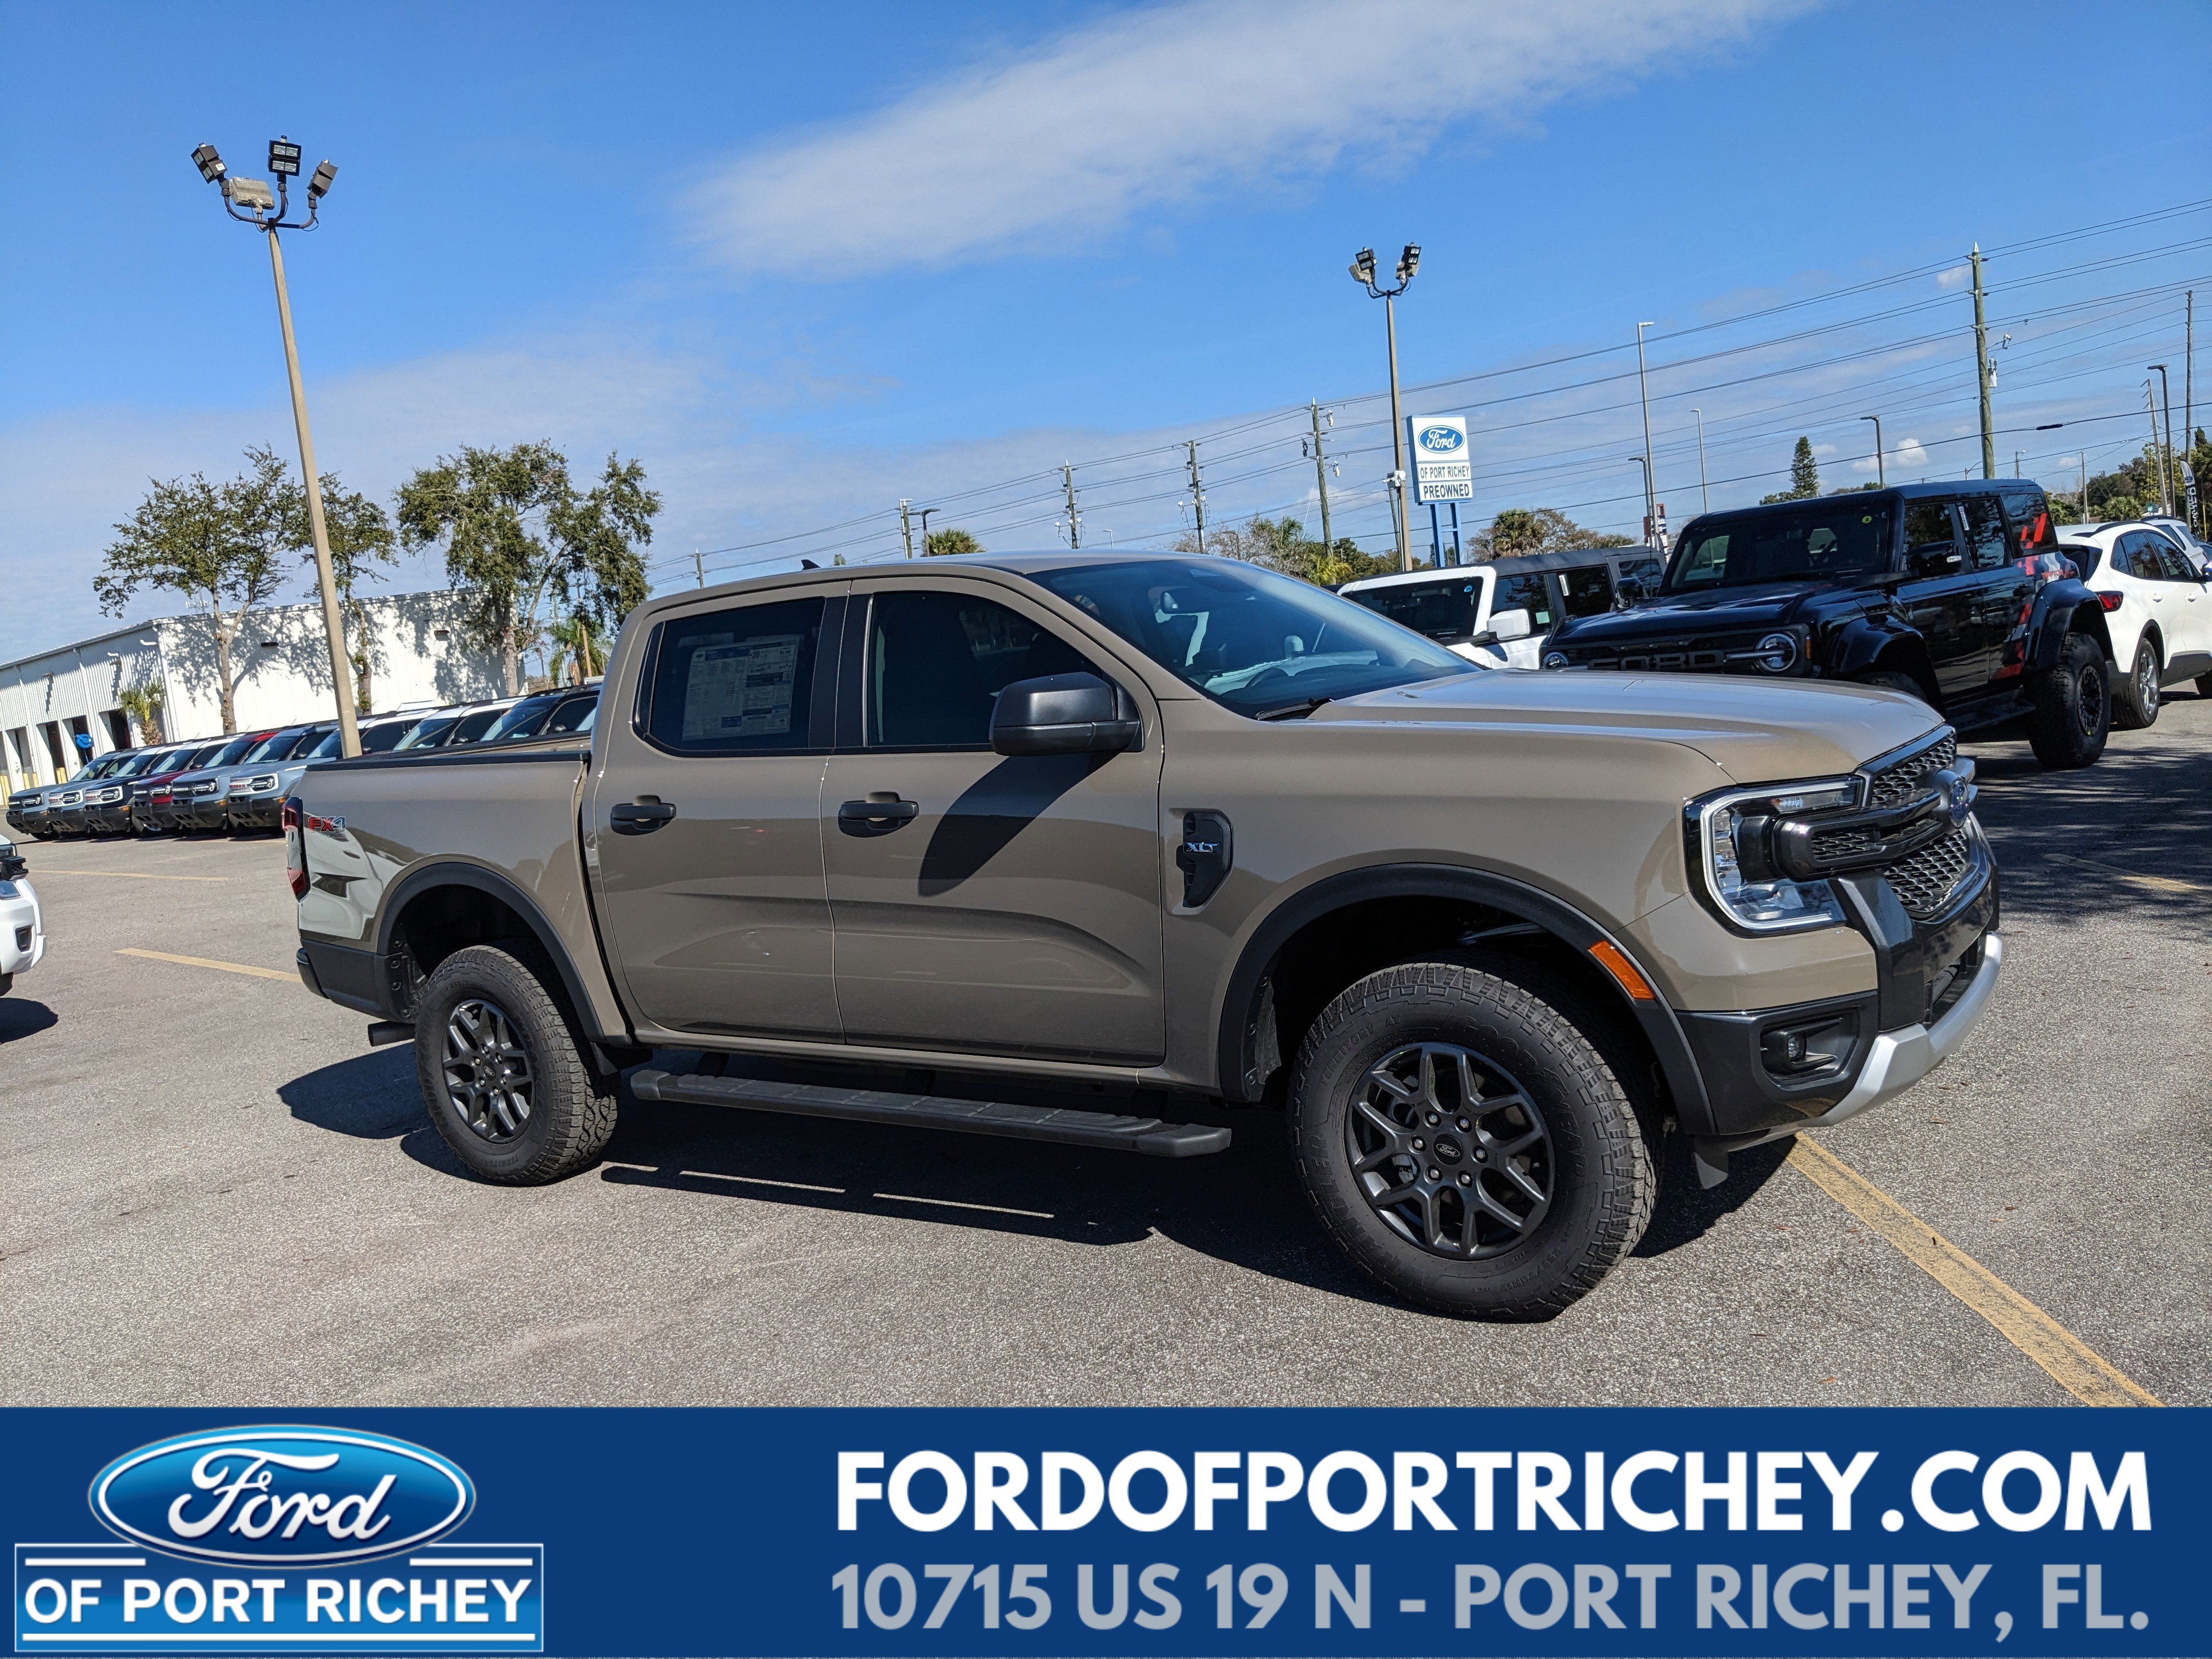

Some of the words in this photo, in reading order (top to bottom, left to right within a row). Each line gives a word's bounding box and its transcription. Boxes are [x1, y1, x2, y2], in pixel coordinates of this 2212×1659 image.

[1426, 428, 1455, 449] Ford
[1420, 467, 1427, 479] OF
[1430, 466, 1445, 478] PORT
[1447, 465, 1469, 478] RICHEY
[1423, 483, 1470, 499] PREOWNED
[308, 816, 346, 833] FX4
[1186, 842, 1220, 853] XLT
[1440, 1144, 1456, 1155] Ford
